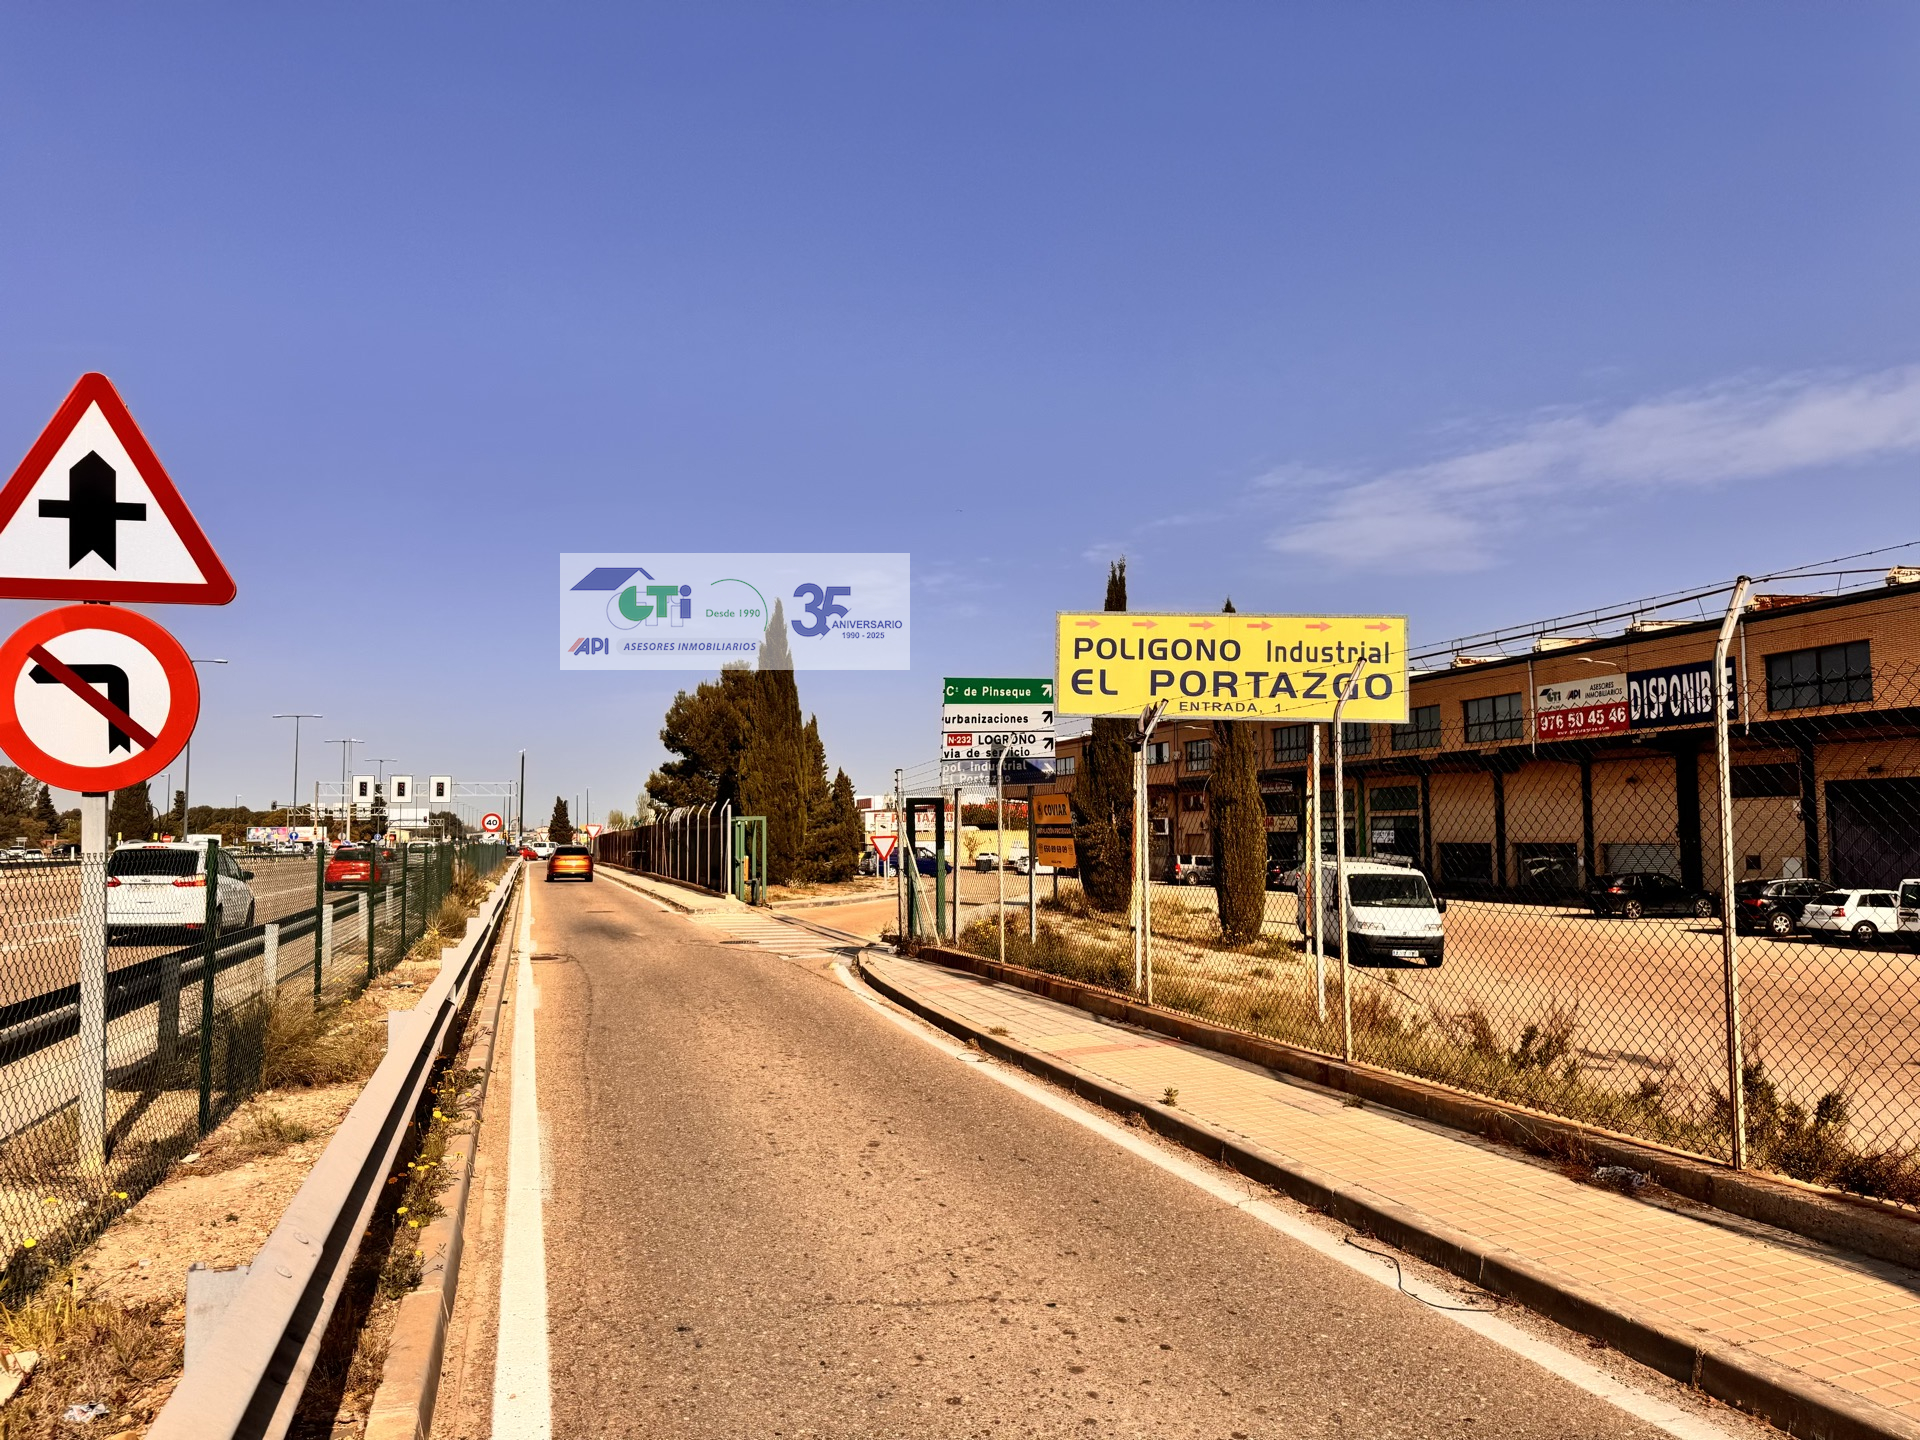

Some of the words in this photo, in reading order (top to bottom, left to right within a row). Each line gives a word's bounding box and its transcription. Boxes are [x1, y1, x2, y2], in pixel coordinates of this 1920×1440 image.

[1074, 637, 1242, 662] POLIGONO
[1267, 640, 1390, 664] Industrial
[1071, 668, 1118, 695] EL
[1150, 669, 1393, 700] PORTAZGO
[1589, 681, 1614, 691] ASESORES
[964, 686, 977, 697] de
[982, 686, 1032, 699] Pinseque
[1629, 667, 1735, 720] DISPONIBE
[1179, 701, 1264, 714] ENTRADA,
[1275, 703, 1282, 713] 1
[945, 713, 1029, 724] urbanizaciones
[1540, 714, 1564, 731] 976
[1567, 711, 1584, 728] 50
[1587, 709, 1605, 726] 45
[1608, 706, 1626, 723] 46
[944, 748, 961, 758] via
[966, 748, 980, 758] de
[960, 773, 1011, 785] Portazo
[1043, 803, 1068, 816] COVIAR
